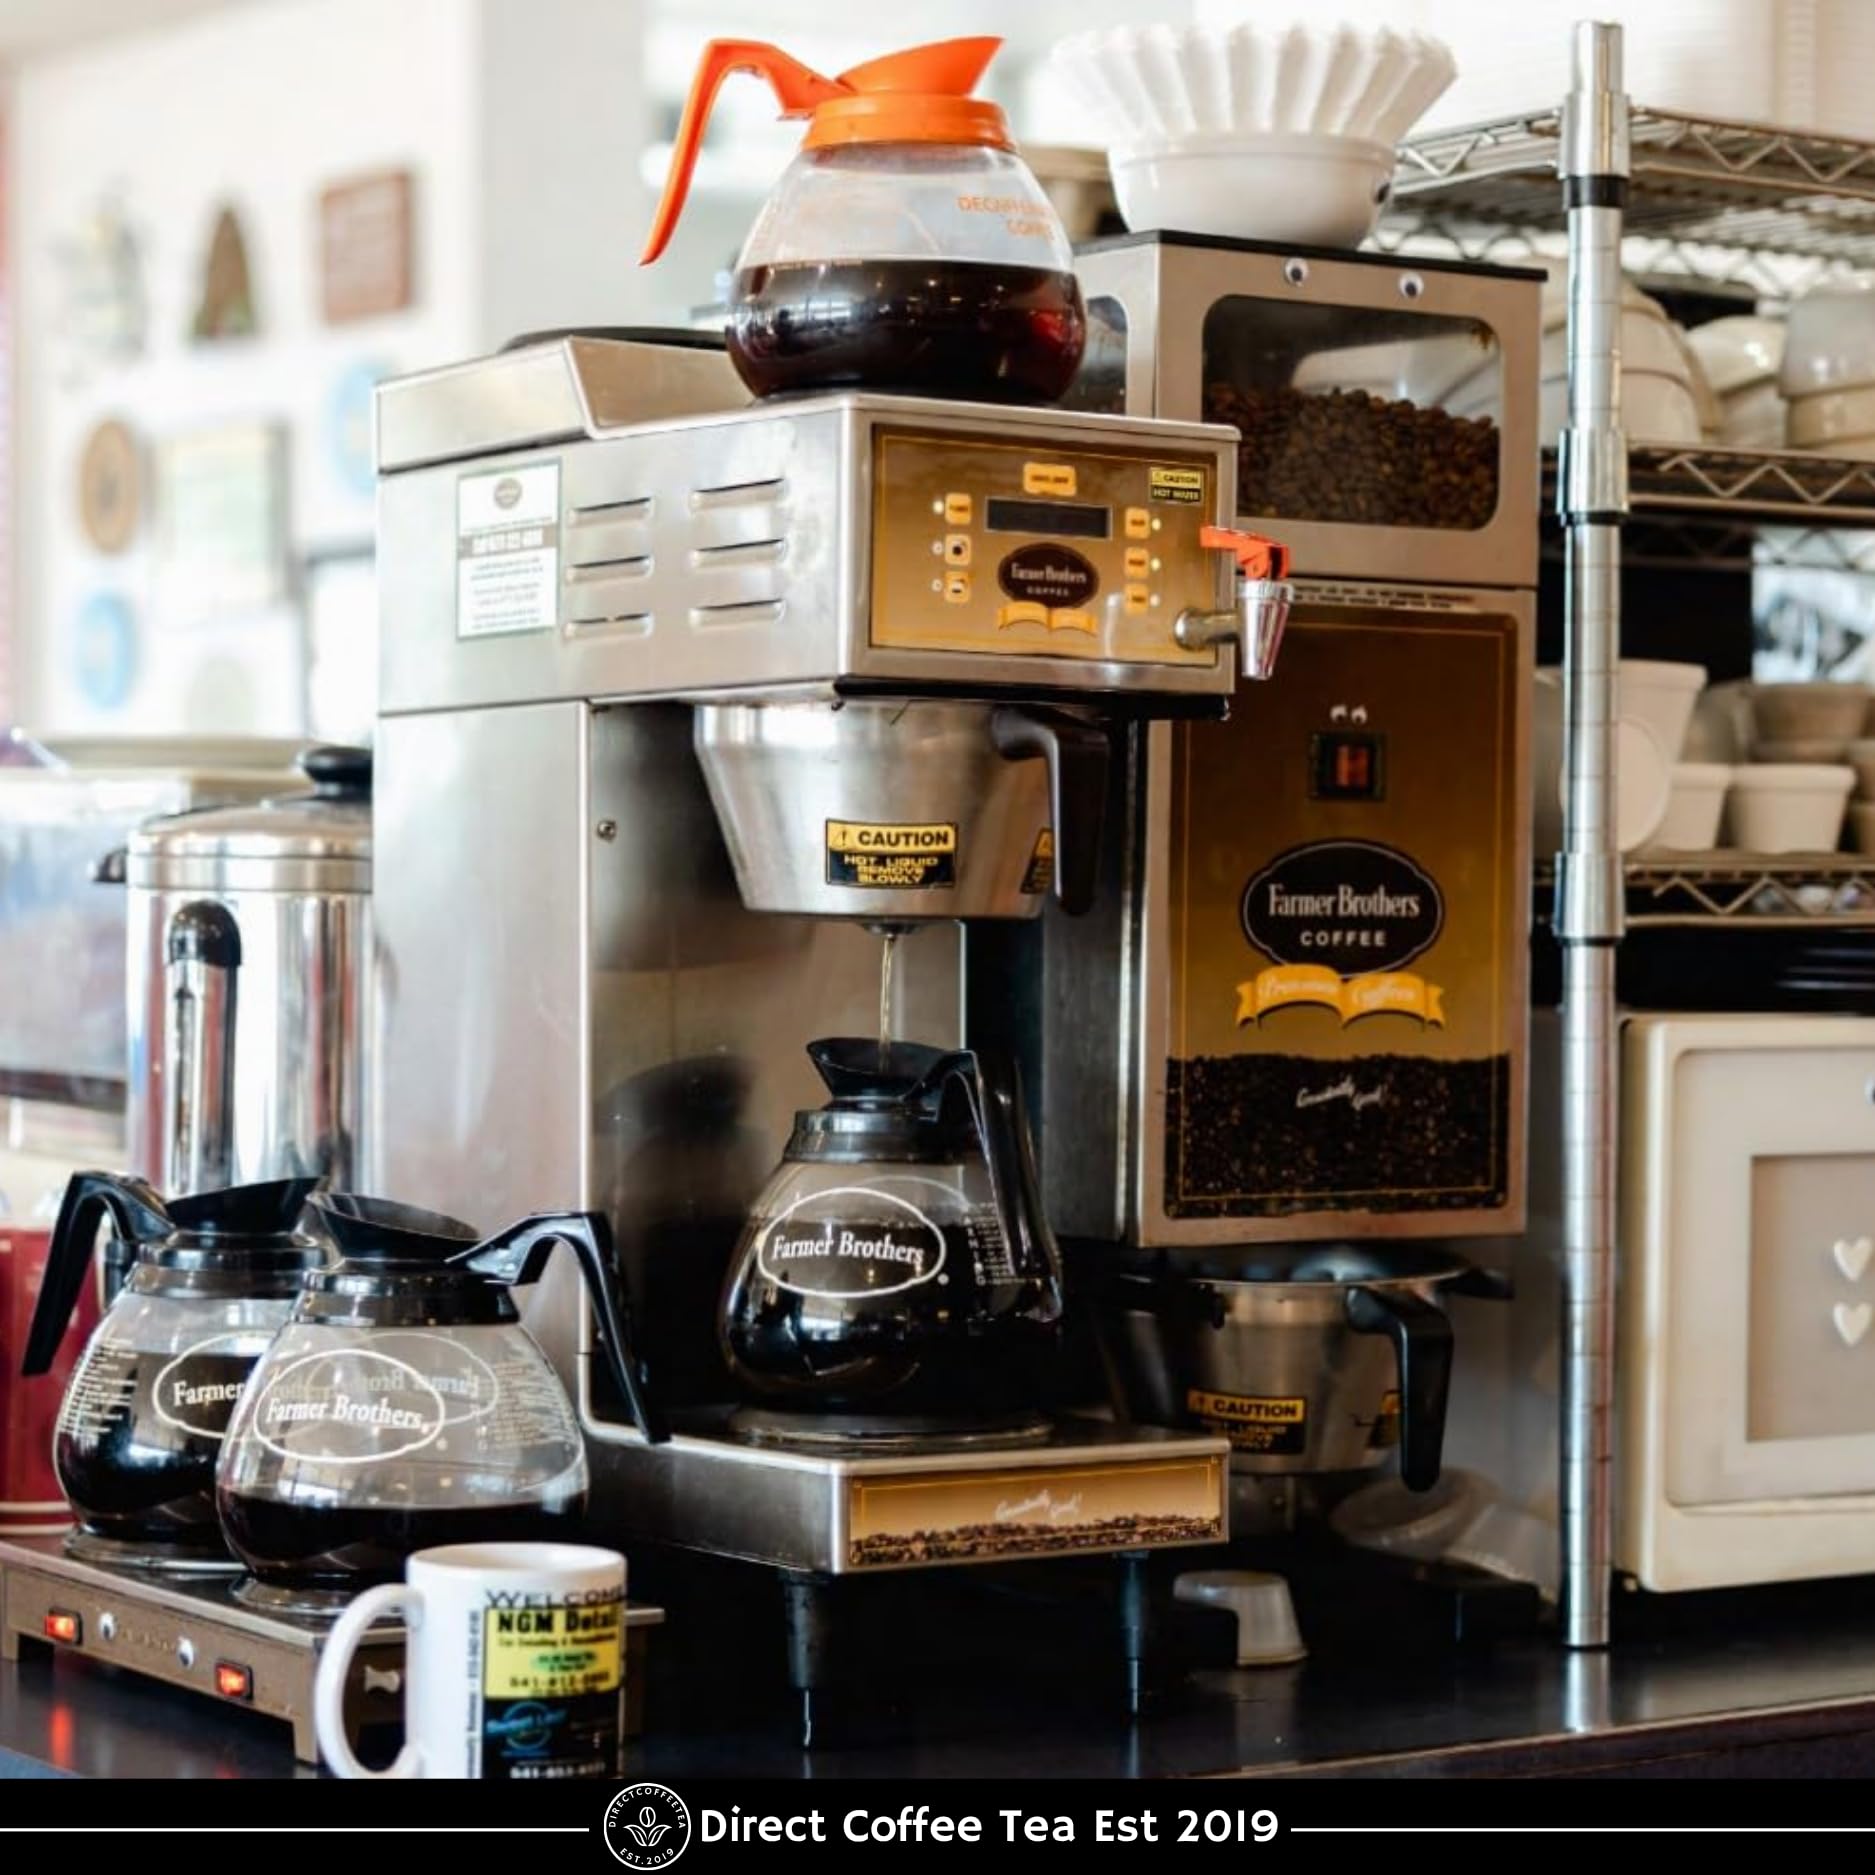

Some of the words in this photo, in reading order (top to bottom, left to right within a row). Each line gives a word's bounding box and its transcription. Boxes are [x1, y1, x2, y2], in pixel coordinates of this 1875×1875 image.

[857, 830, 949, 847] CAUTION
[844, 854, 877, 865] HOT
[885, 855, 939, 867] LIQUID
[857, 873, 922, 884] SLOWLY
[1268, 883, 1335, 916] Farmer
[1338, 883, 1420, 917] Brothers
[1300, 930, 1387, 947] COFFEE
[771, 1234, 834, 1260] Farmer
[837, 1230, 924, 1264] Brothers
[173, 1381, 245, 1406] Farmer
[266, 1399, 328, 1423] Farmer
[332, 1395, 423, 1429] Brothers
[1213, 1400, 1298, 1417] CAUTION
[499, 1611, 554, 1633] NGM
